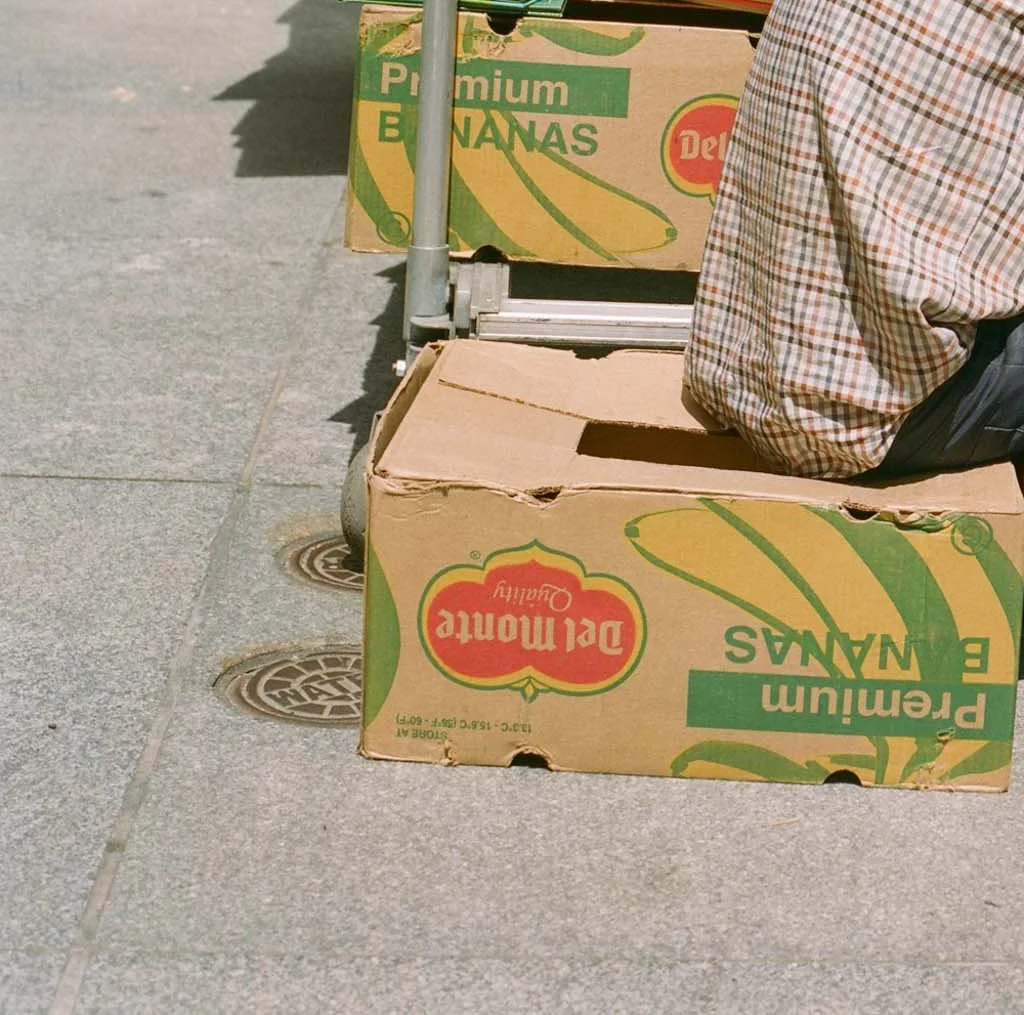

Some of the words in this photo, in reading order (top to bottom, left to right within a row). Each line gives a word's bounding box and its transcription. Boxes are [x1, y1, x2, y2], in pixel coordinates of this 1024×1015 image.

[380, 61, 570, 107] Prmium
[377, 110, 600, 157] BNANAS
[679, 129, 727, 161] Del
[491, 579, 574, 613] Quality
[435, 608, 557, 651] Monte
[565, 617, 625, 656] Del
[724, 624, 991, 674] BNANAS
[265, 675, 362, 709] WAT
[761, 683, 987, 730] Premium
[395, 728, 409, 739] AT
[412, 728, 449, 740] STORE
